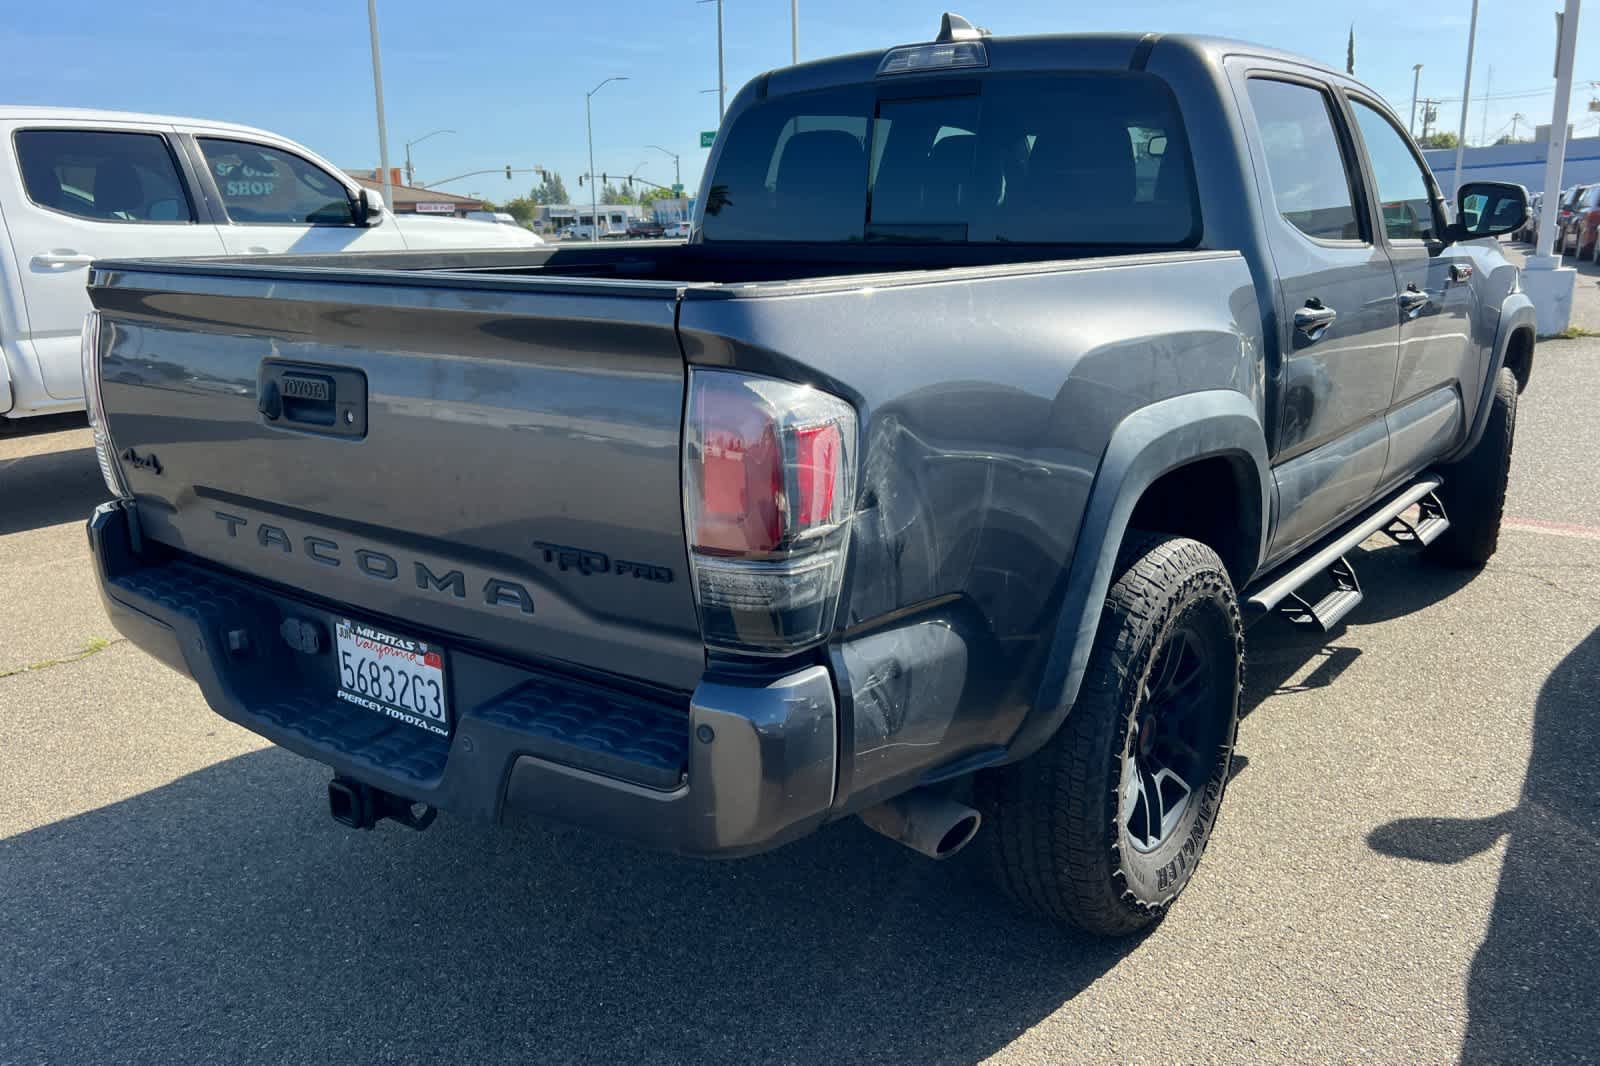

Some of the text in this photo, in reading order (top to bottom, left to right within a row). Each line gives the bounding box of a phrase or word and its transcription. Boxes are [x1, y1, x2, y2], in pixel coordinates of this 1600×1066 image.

[282, 379, 328, 399] TOYOTA
[215, 511, 535, 615] TACOMA
[533, 540, 611, 577] TRD
[356, 626, 415, 652] MILPITAS
[337, 690, 384, 712] PIERCEY
[341, 650, 442, 718] 56832G3
[1156, 764, 1224, 892] RANGLER
